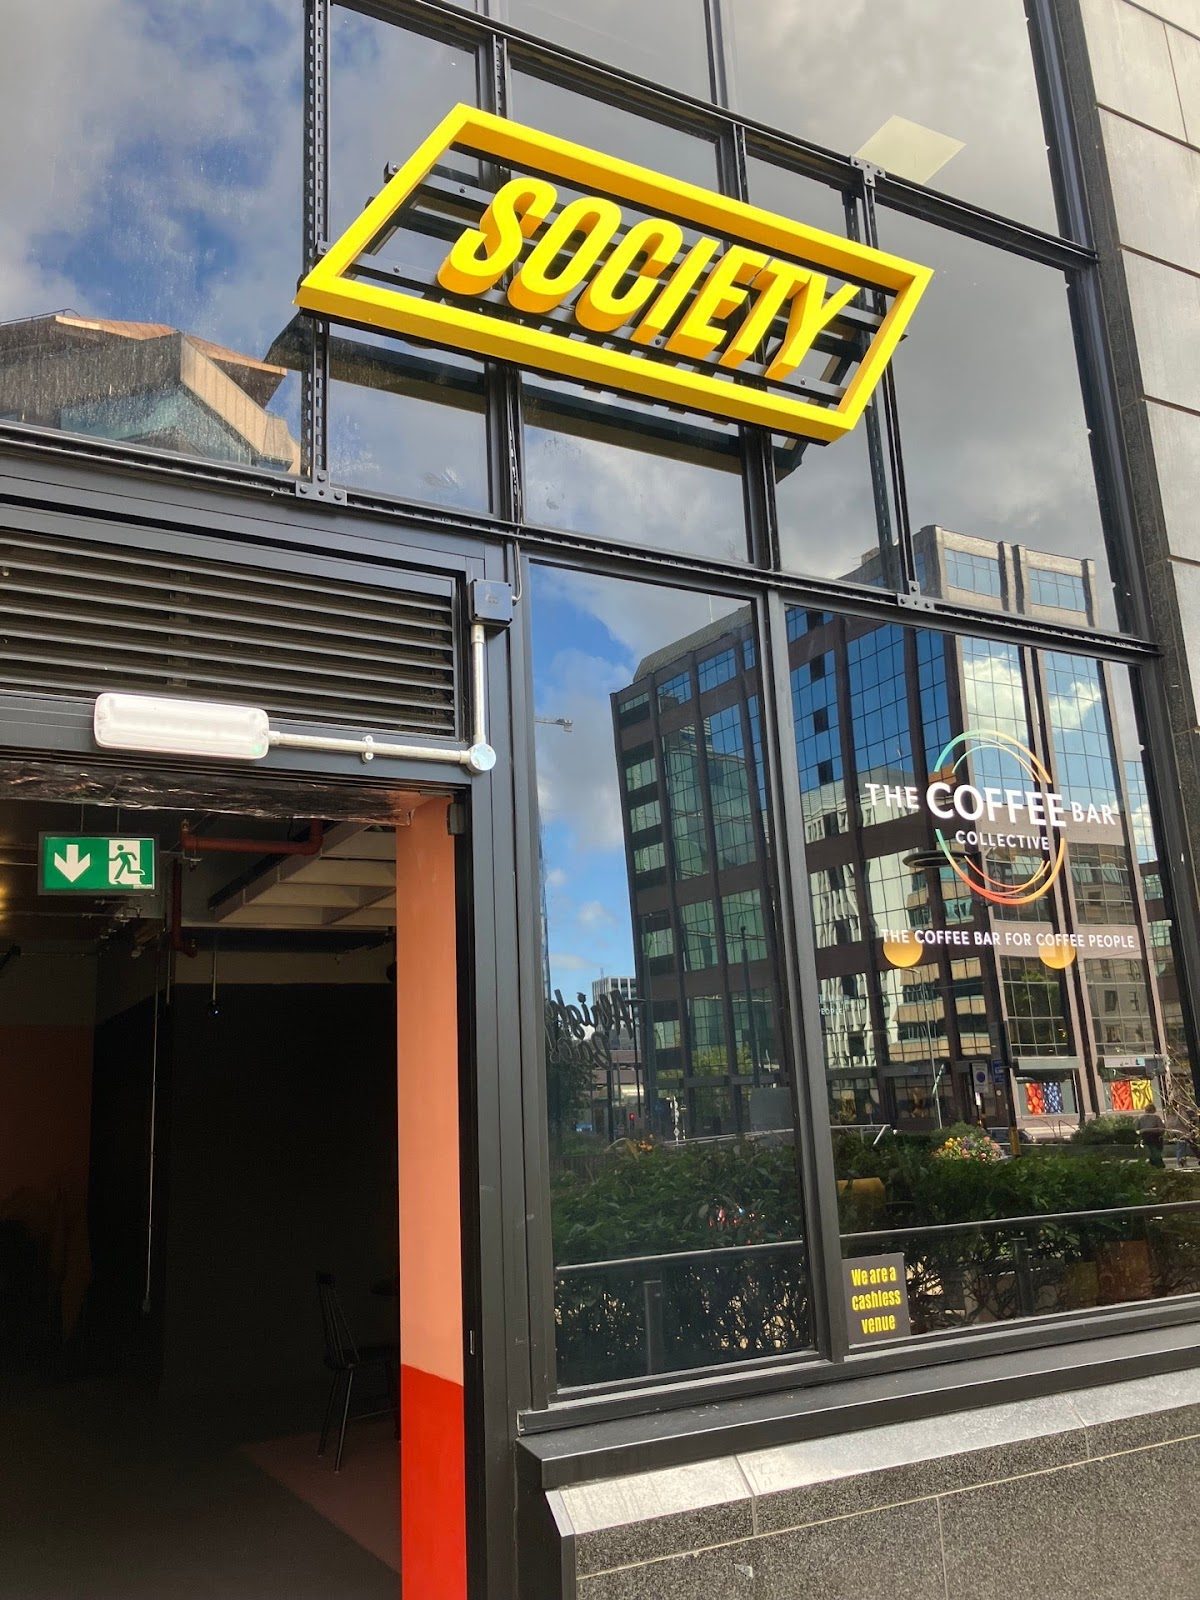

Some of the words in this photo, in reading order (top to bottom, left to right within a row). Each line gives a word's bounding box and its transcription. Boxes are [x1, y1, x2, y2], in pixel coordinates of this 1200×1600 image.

[438, 177, 861, 381] SOCIETY
[865, 783, 920, 809] THE
[926, 781, 1067, 827] COFFEE
[1071, 801, 1117, 826] BAR
[955, 830, 1050, 851] COLLECTIVE
[881, 929, 910, 944] THE
[914, 929, 970, 945] COFFEE
[973, 931, 1002, 946] BAR
[1004, 932, 1032, 947] FOR
[1035, 933, 1086, 948] COFFEE
[1087, 934, 1136, 949] PEOPLE
[851, 1268, 869, 1287] We
[869, 1267, 888, 1284] are
[889, 1266, 897, 1281] a
[851, 1289, 901, 1311] cashless
[861, 1314, 896, 1334] venue
